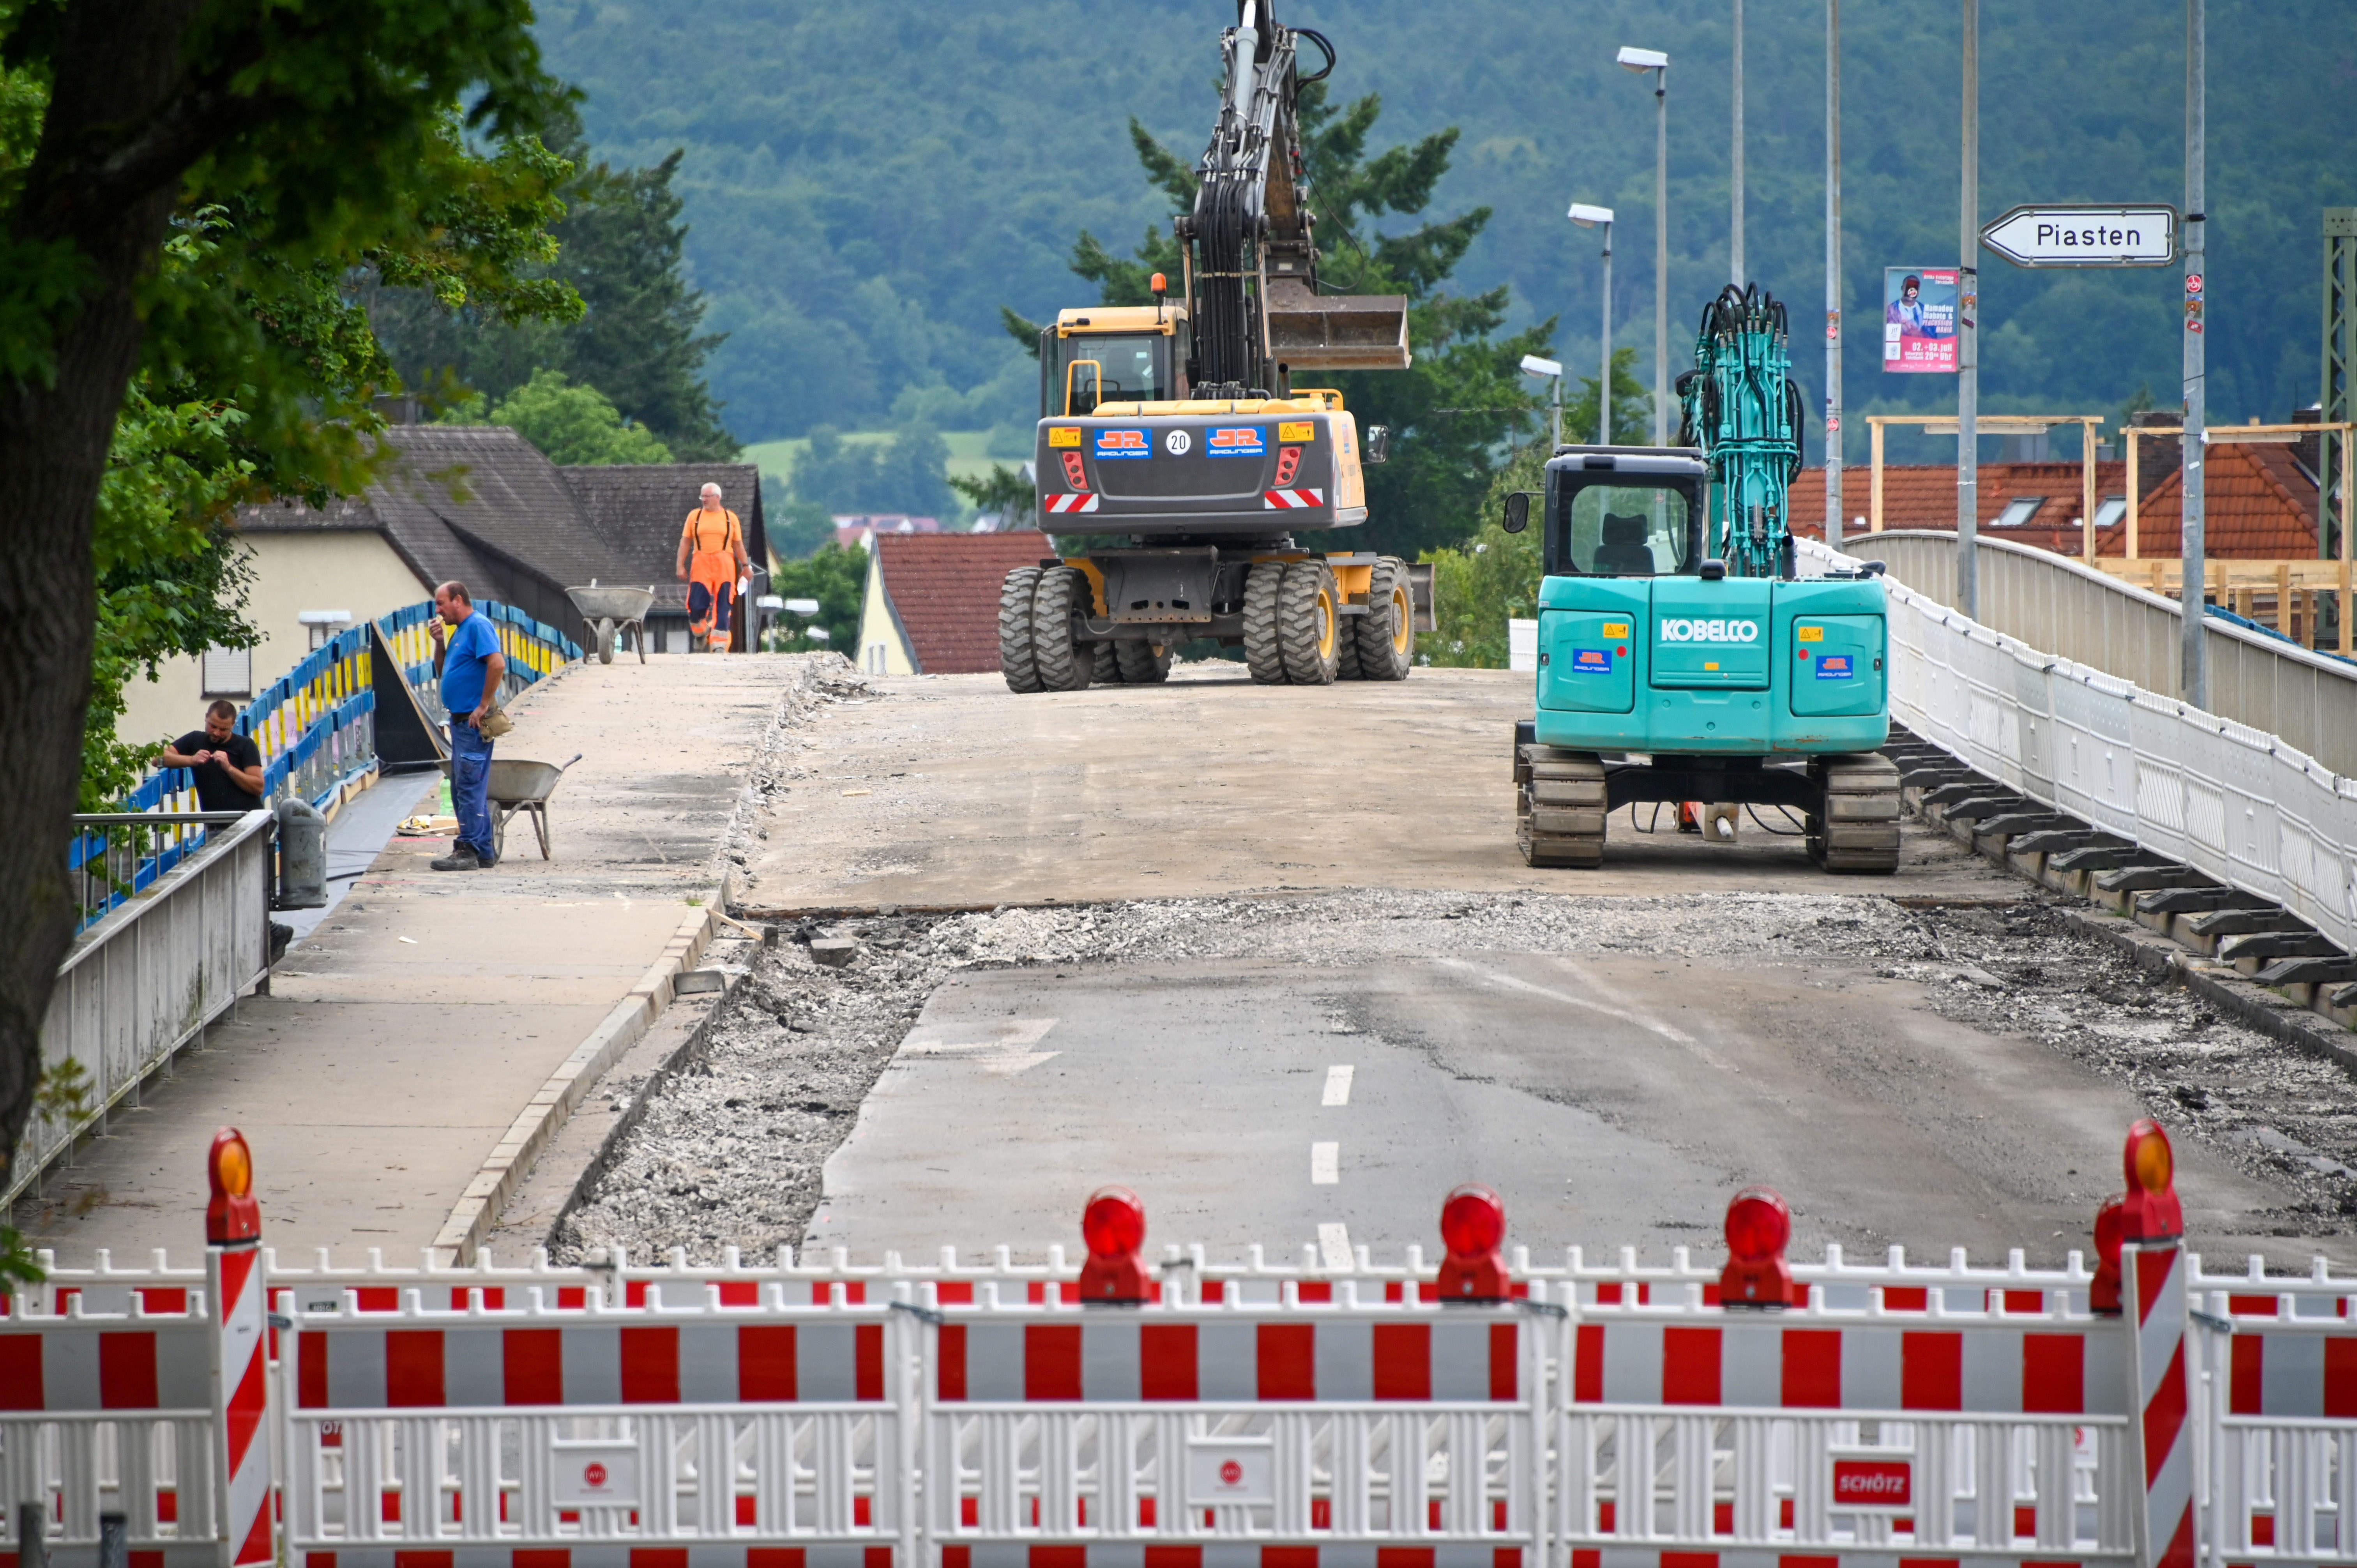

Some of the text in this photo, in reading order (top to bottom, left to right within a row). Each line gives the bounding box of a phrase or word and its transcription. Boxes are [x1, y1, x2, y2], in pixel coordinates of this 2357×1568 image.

[2038, 224, 2140, 245] Piasten
[1171, 435, 1186, 449] 20
[1661, 619, 1758, 642] KOBELCO
[1839, 1473, 1905, 1493] SCHÖTZ
